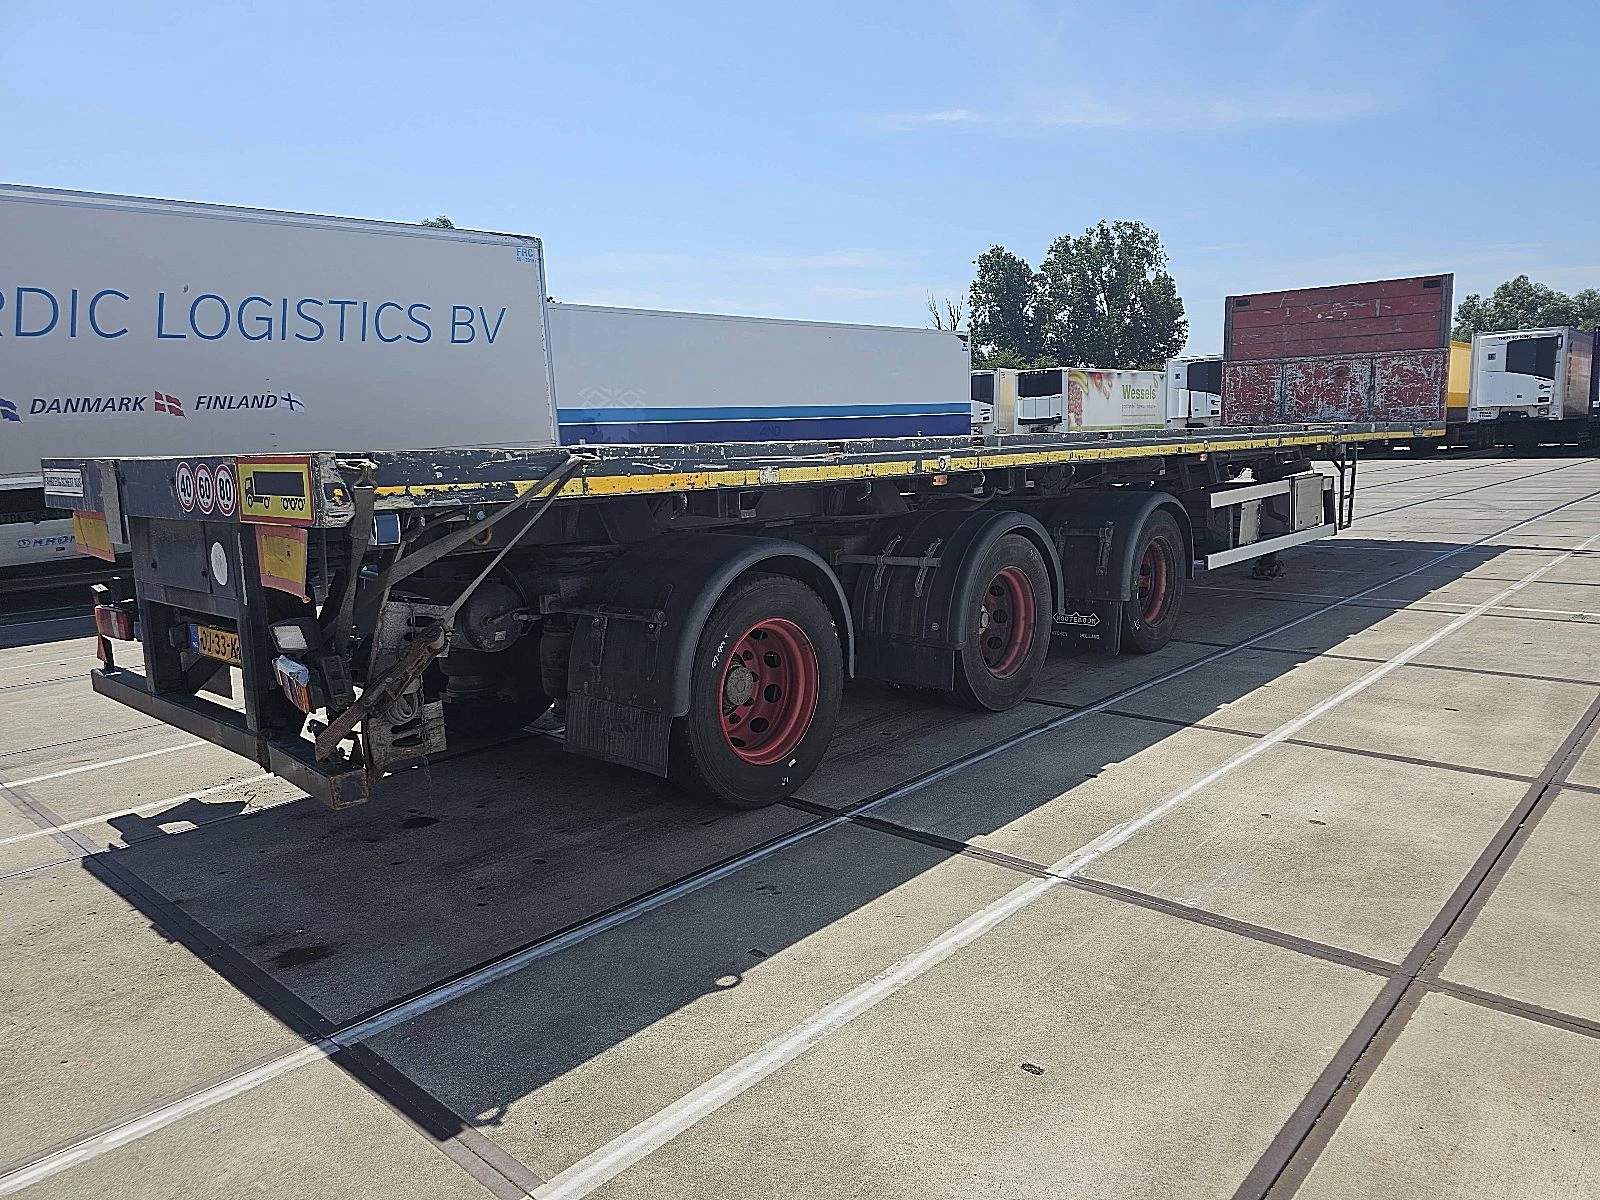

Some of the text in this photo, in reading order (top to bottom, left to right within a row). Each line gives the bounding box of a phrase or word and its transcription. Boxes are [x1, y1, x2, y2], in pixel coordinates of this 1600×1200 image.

[516, 248, 533, 257] FRC
[157, 292, 432, 343] LOGISTICS
[450, 305, 506, 344] BV
[1121, 384, 1156, 400] Wessels
[30, 394, 278, 415] DANMARK FINLAND
[181, 475, 191, 497] 40
[199, 477, 210, 499] 60
[219, 478, 231, 501] 80
